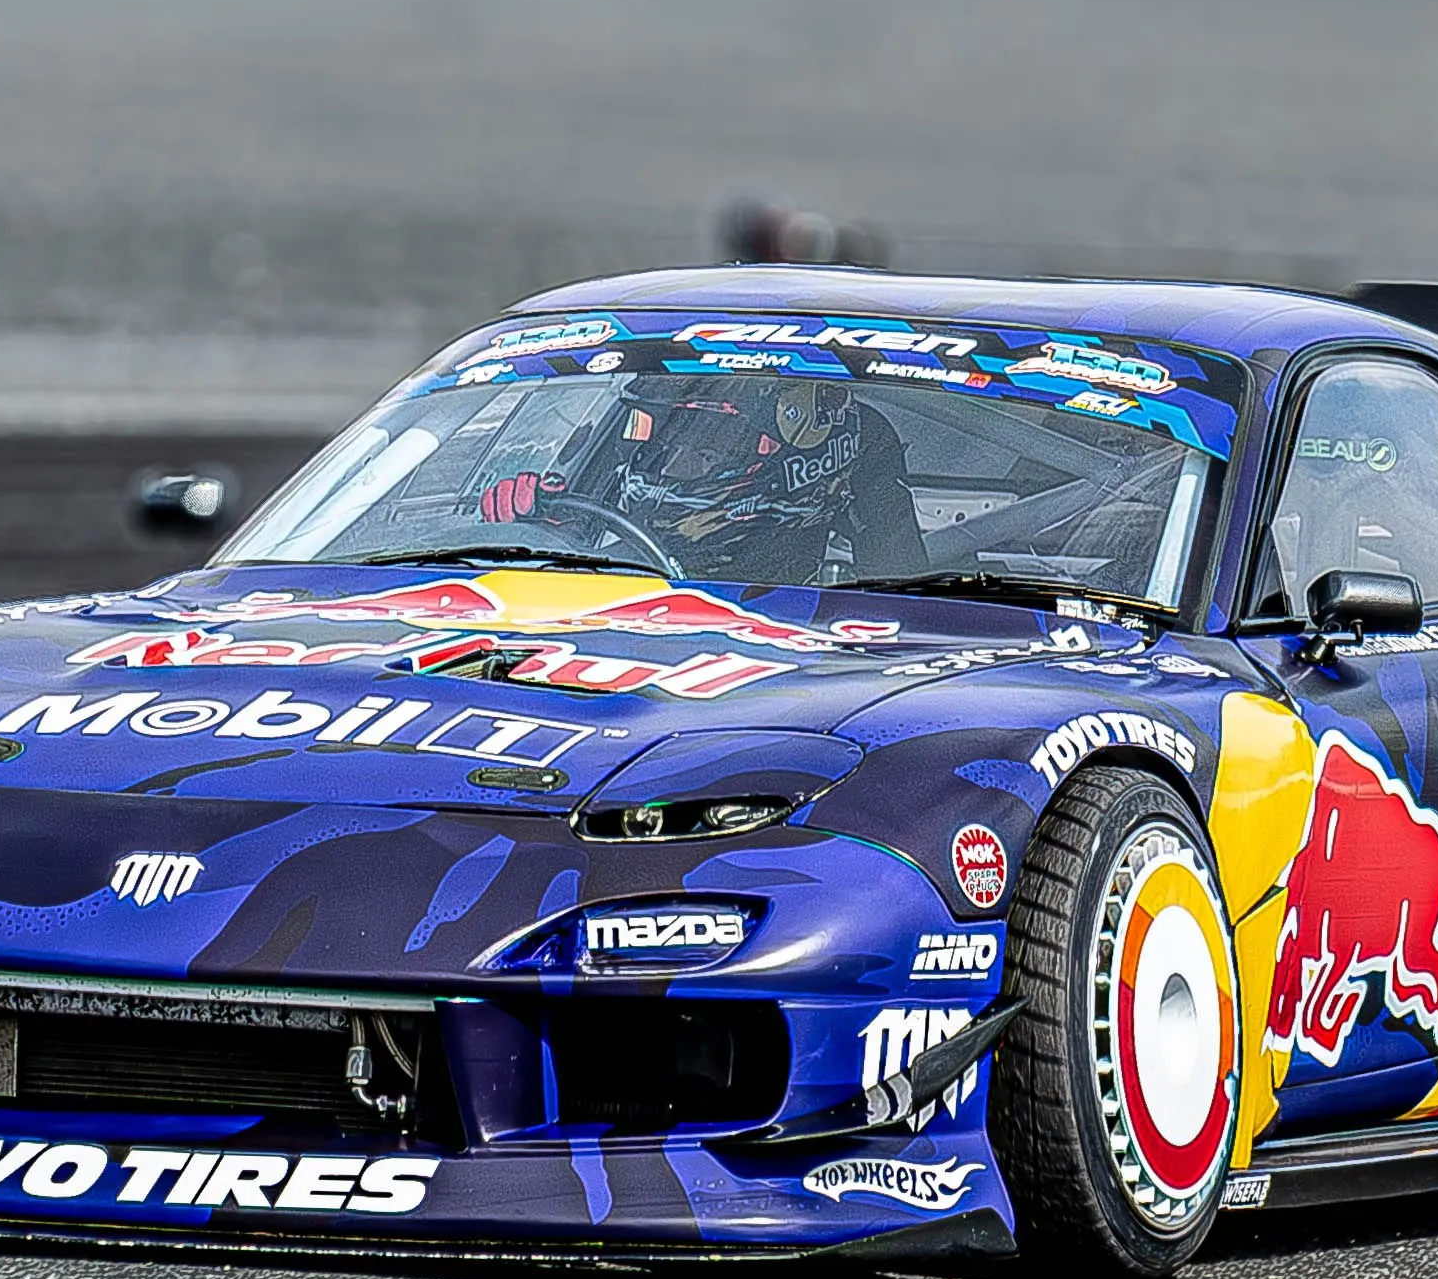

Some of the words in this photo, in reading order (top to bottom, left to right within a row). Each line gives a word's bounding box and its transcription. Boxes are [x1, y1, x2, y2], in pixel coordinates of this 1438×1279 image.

[673, 324, 977, 356] FALKEN
[784, 437, 838, 491] Red
[1029, 715, 1111, 789] TOYO
[1098, 712, 1196, 774] TIRES
[960, 843, 998, 865] NGK
[586, 914, 744, 949] mazda
[912, 933, 998, 971] INNO
[116, 1146, 441, 1213] TIRES
